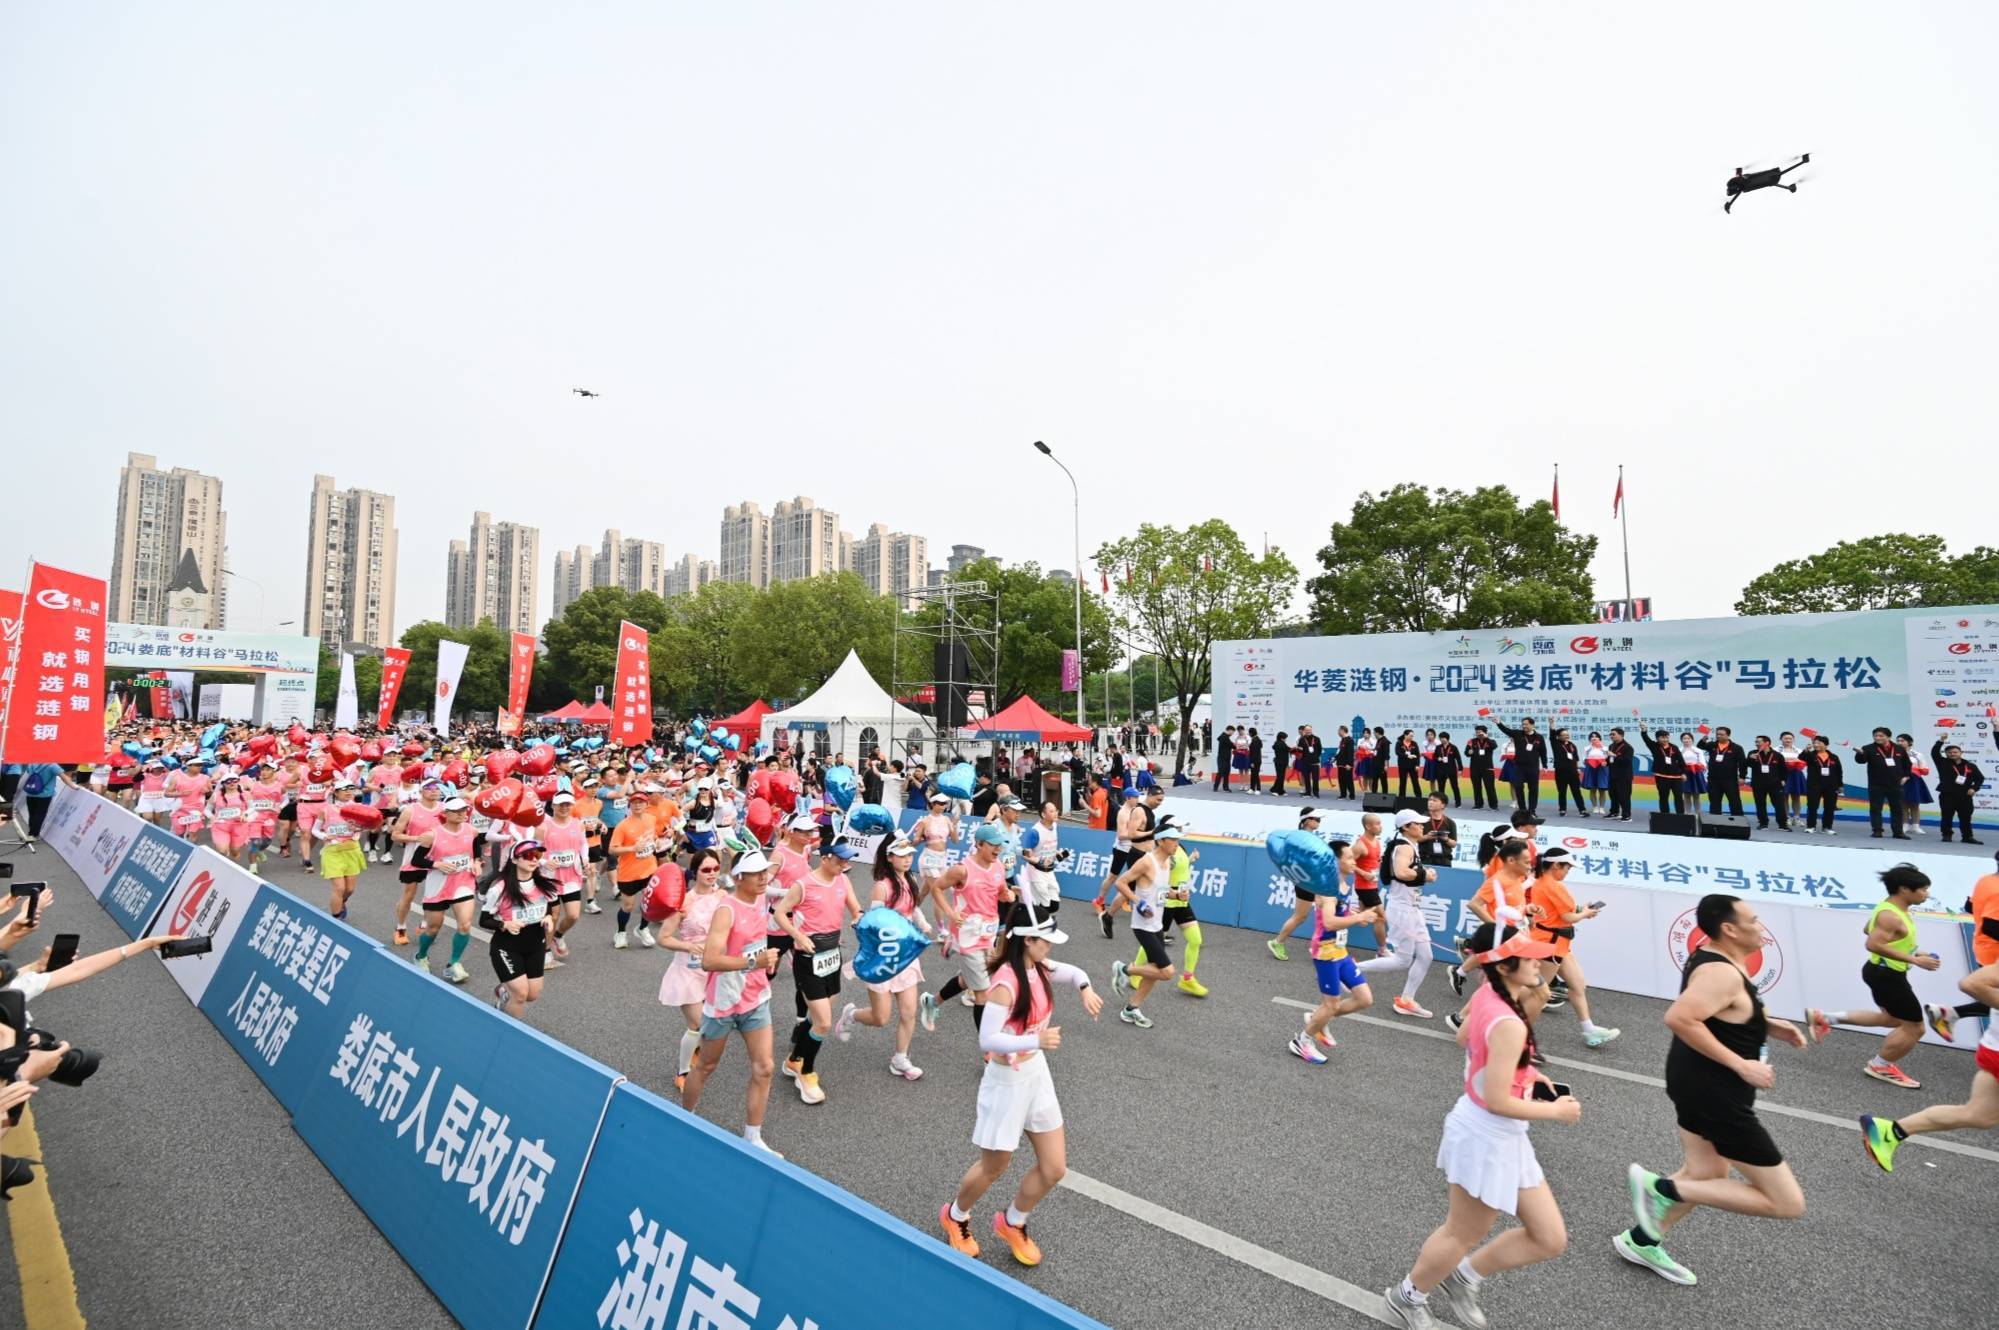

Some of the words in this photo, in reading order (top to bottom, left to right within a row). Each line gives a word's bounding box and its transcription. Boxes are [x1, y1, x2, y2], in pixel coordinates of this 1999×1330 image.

[70, 627, 91, 711] 买钢用钢
[105, 641, 278, 662] 024娄底"材料谷"马拉松
[33, 652, 67, 740] 就选涟钢
[520, 747, 546, 765] 4:00
[481, 785, 512, 809] 6:00
[247, 902, 351, 1006] 娄底市娄星区
[876, 926, 900, 976] 2:00
[1757, 968, 1776, 990] ciation
[227, 970, 299, 1067] 人民政府
[330, 1012, 556, 1246] 娄底市人民政府
